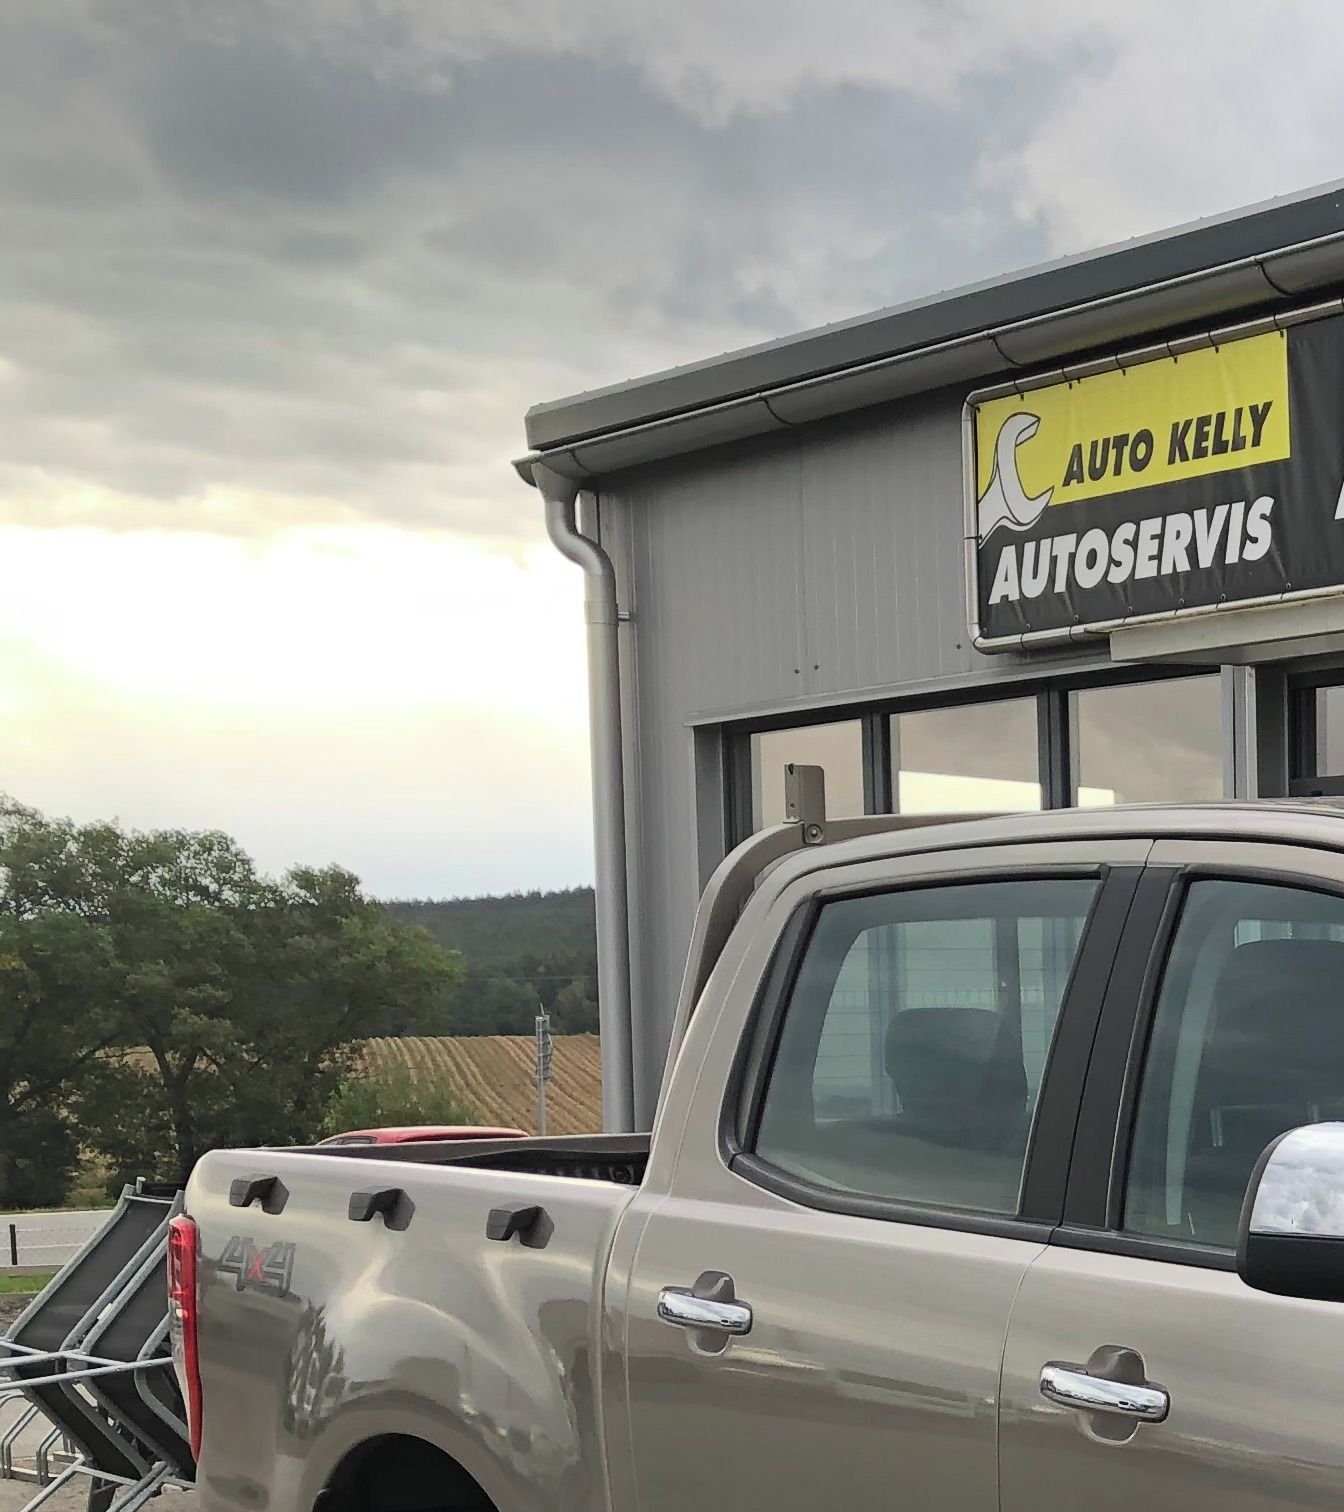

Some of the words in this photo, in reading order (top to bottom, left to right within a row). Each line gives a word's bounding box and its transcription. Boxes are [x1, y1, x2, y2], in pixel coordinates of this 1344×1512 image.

[1062, 428, 1154, 487] AUTO
[1168, 401, 1274, 466] KELLY
[988, 496, 1275, 605] AUTOSERVIS
